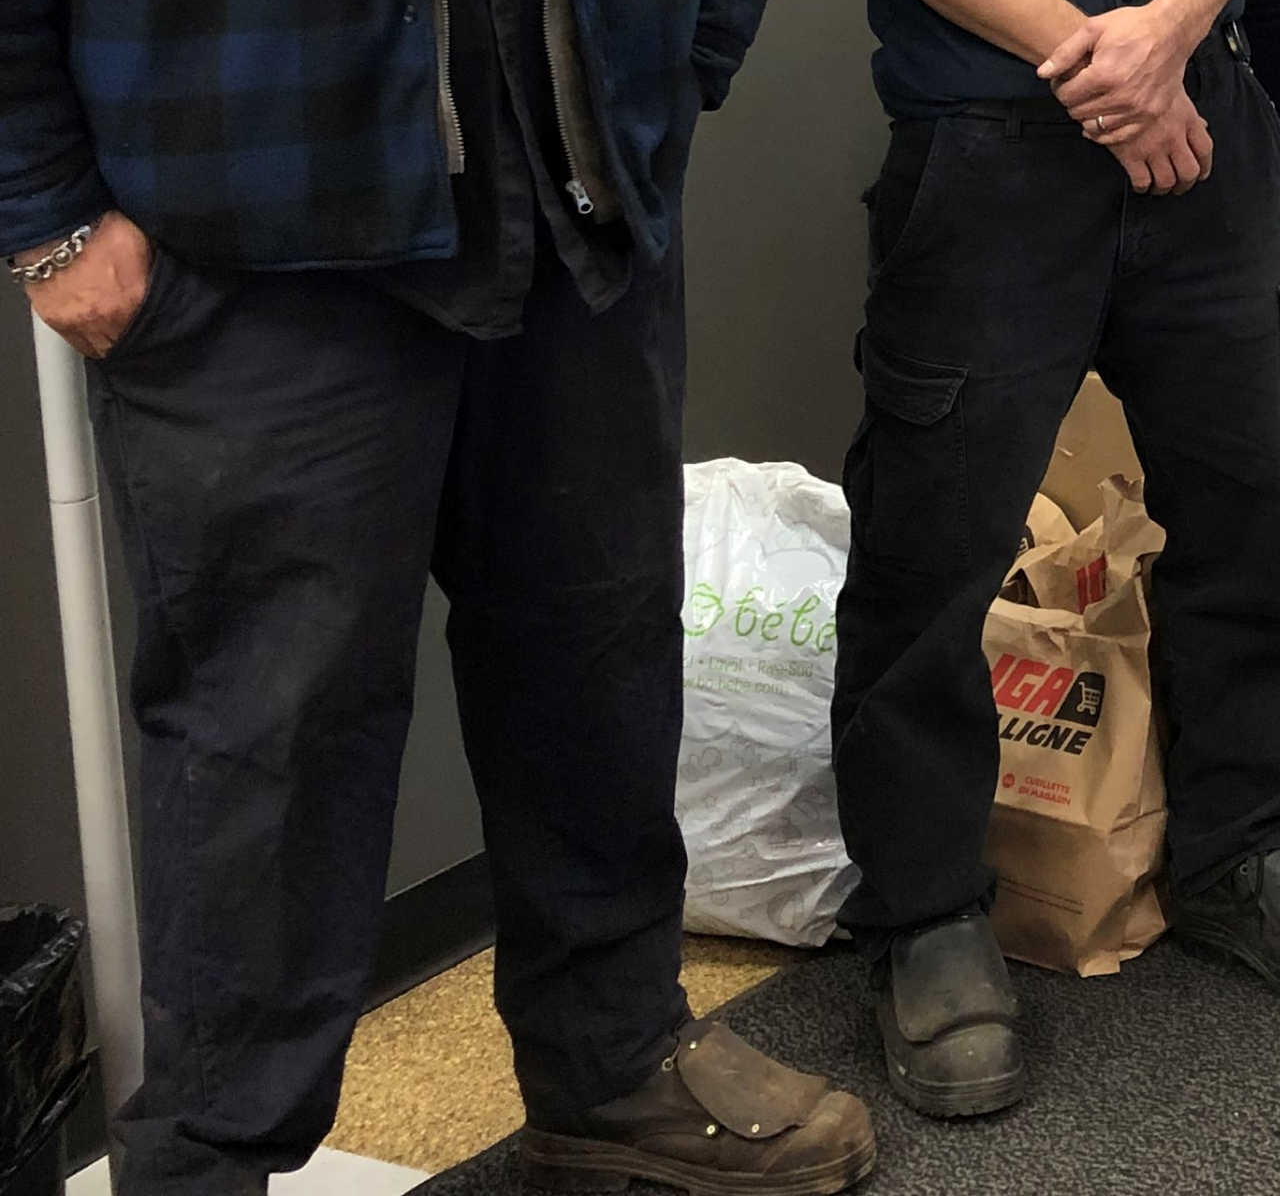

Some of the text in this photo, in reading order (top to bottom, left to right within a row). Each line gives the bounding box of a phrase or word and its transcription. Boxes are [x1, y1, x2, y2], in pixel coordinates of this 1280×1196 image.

[991, 653, 1075, 717] IGA
[999, 716, 1093, 756] LIGNE
[1024, 776, 1071, 794] CUEILLETTE
[1030, 788, 1071, 806] MAGASIN
